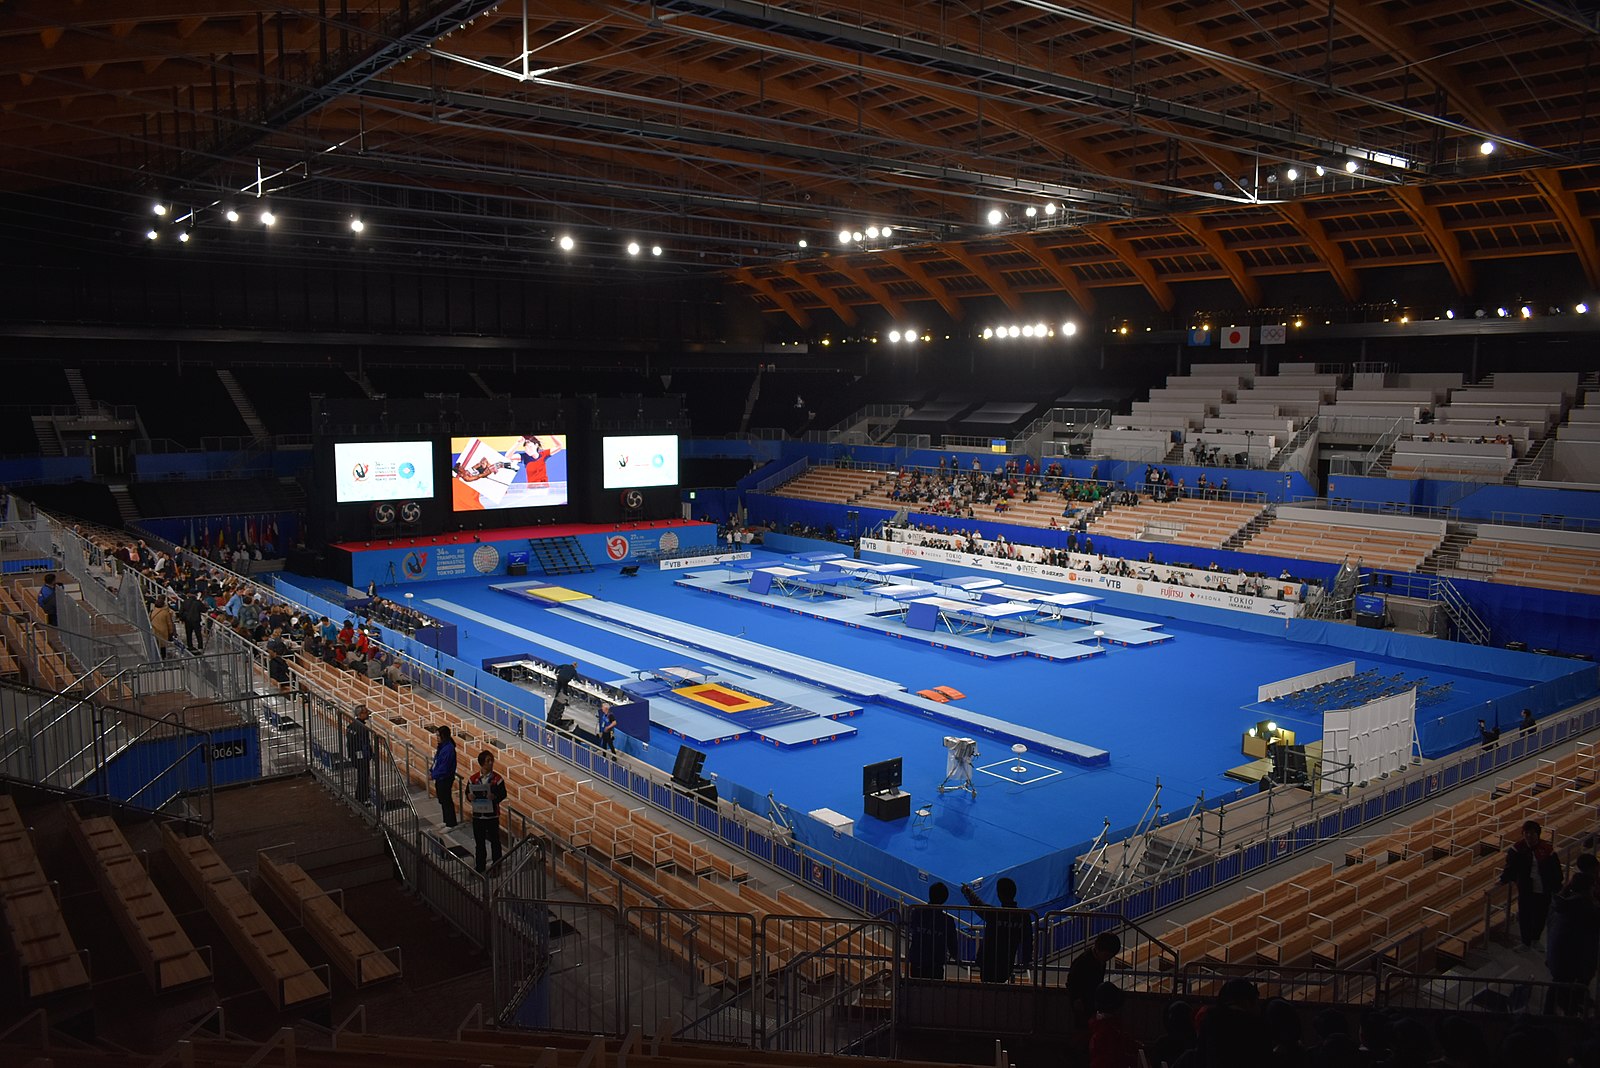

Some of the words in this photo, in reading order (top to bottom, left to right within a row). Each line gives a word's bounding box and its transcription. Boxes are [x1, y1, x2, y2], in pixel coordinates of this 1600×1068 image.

[865, 542, 877, 550] VTB
[1023, 565, 1038, 573] INTEC
[1105, 578, 1121, 589] VTB
[1211, 575, 1231, 584] INTEC
[1160, 587, 1184, 599] FUJITSU
[1197, 594, 1221, 602] PASONA
[1228, 595, 1254, 605] TOKIO
[213, 747, 232, 759] 006
